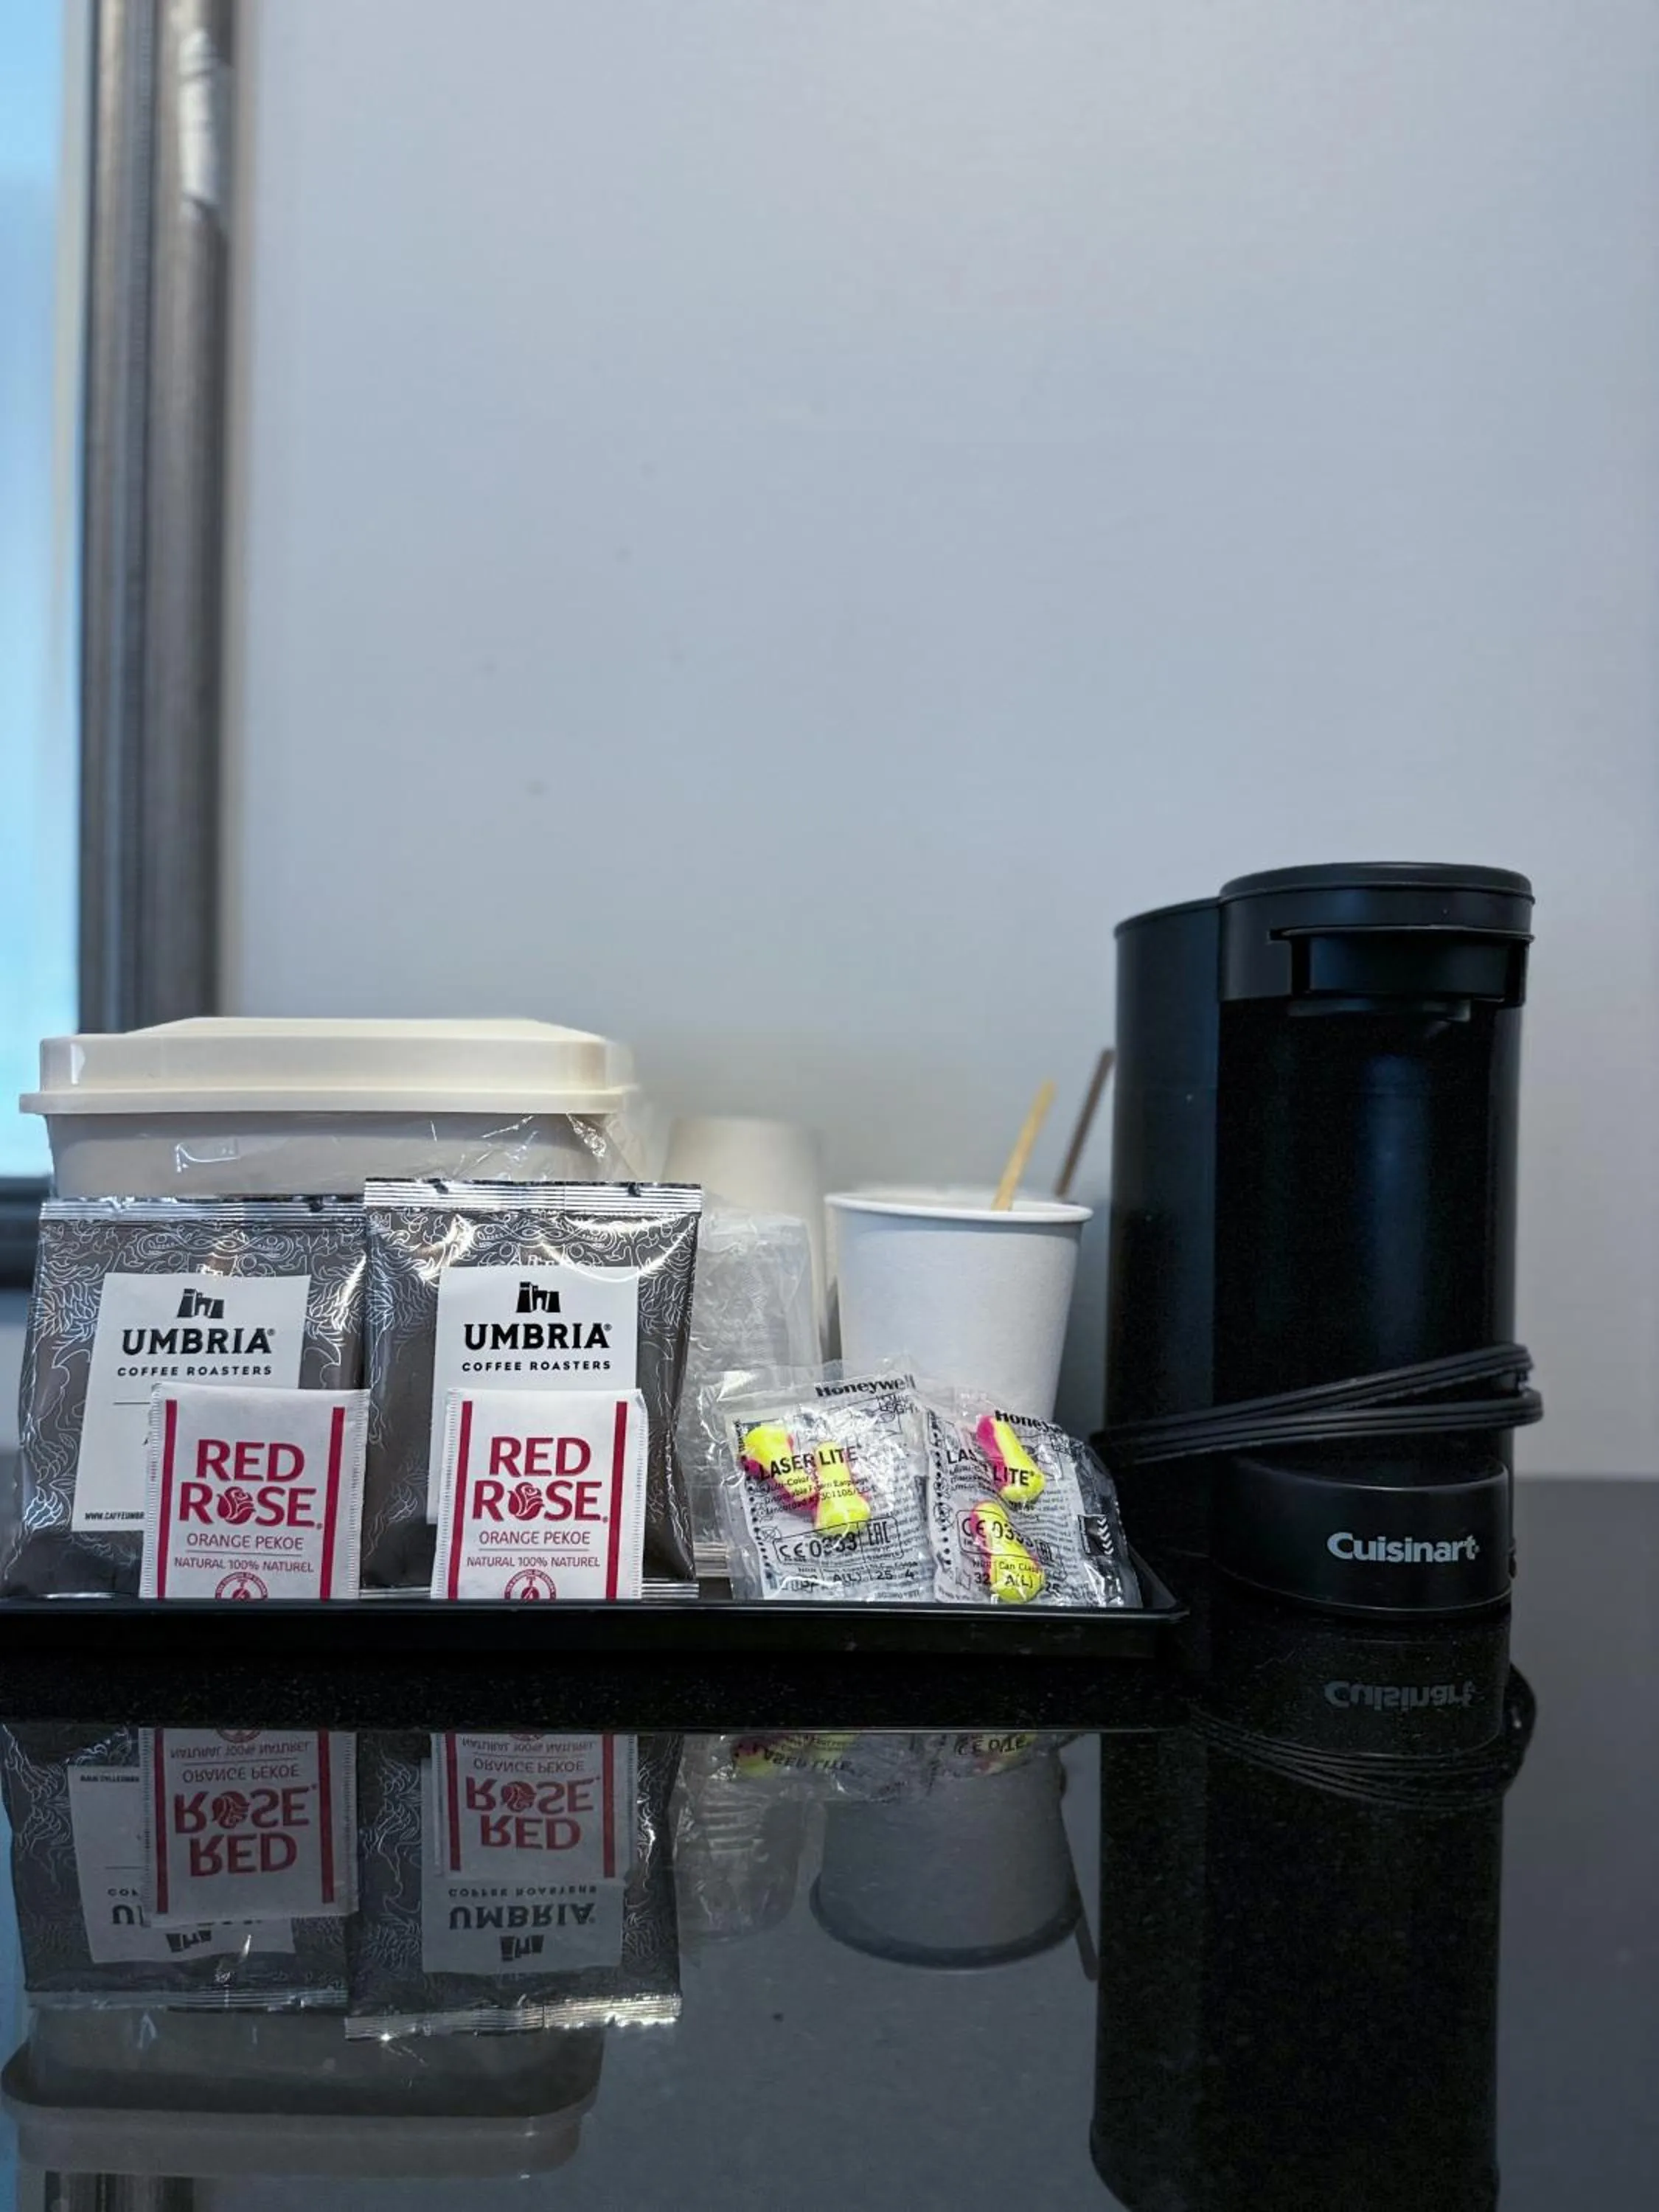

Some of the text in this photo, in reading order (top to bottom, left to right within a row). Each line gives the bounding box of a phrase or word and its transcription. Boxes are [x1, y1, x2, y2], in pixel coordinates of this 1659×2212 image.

[117, 1364, 272, 1377] COFFEE ROASTERS
[462, 1360, 611, 1371] COFFEE ROASTERS
[815, 1374, 916, 1397] Honeywell
[195, 1439, 305, 1482] RED
[490, 1436, 591, 1477] RED
[758, 1446, 858, 1481] LASER LITE
[993, 1465, 1029, 1486] LITE
[187, 1533, 303, 1550] ORANGE PEKOE
[479, 1531, 591, 1545] ORANGE PEKOE
[1326, 1531, 1478, 1563] Cuisinart
[174, 1557, 314, 1573] NATURAL 100% NATUREL
[467, 1557, 601, 1568] NATURAL 100% NATUREL
[875, 1570, 894, 1580] 25
